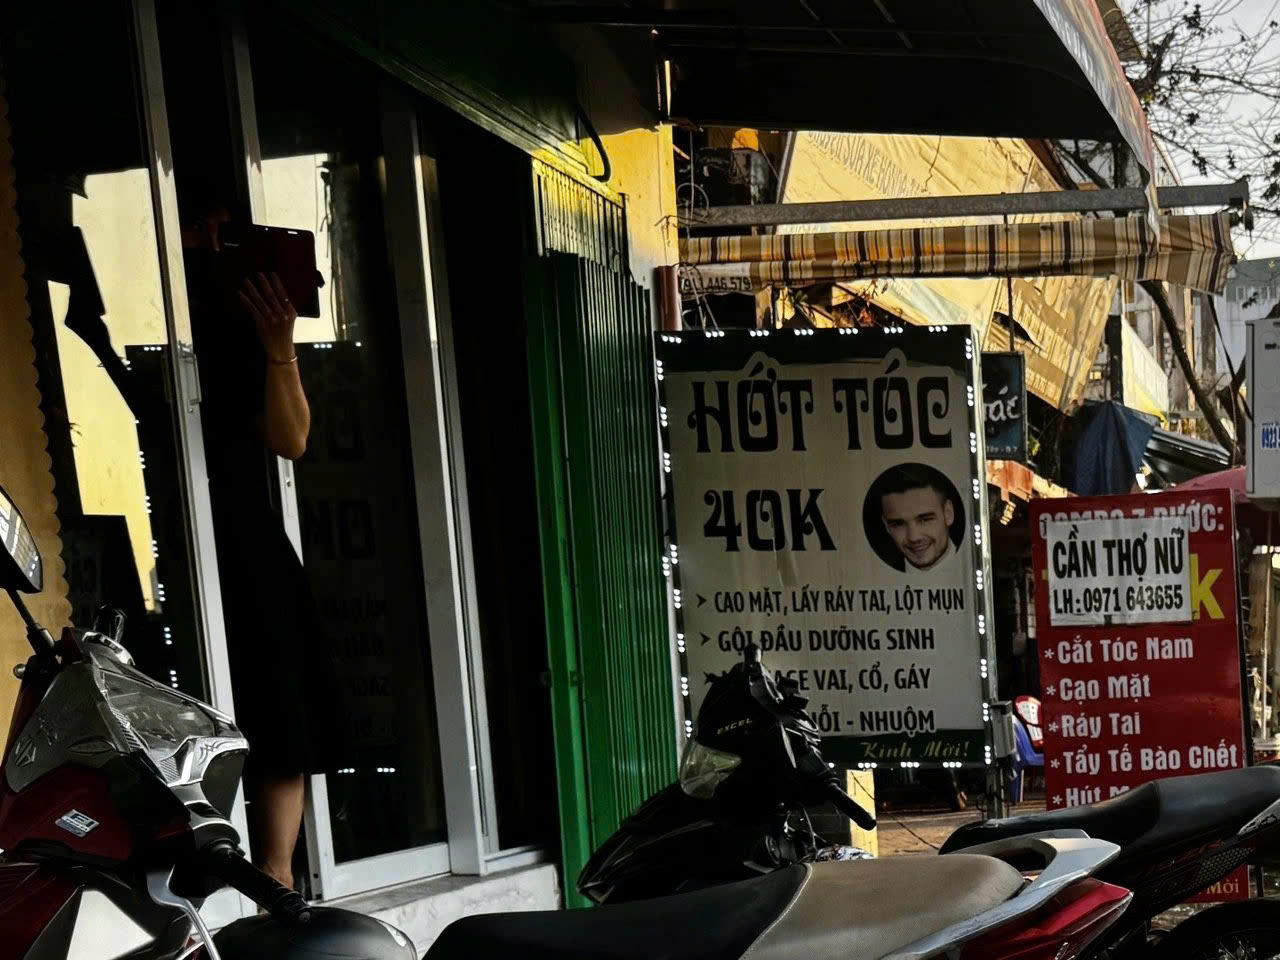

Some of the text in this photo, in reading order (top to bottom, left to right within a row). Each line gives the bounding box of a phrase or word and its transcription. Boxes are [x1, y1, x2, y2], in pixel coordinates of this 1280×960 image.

[688, 359, 952, 452] HỚT TÓC
[704, 489, 836, 552] 40K
[1053, 524, 1185, 582] CẦN THỢ NỮ
[714, 585, 965, 616] CAO MẶT, LẤY RÁY TAI, LỘT MỤN
[1126, 584, 1183, 611] 643655
[759, 624, 802, 652] ĐẦU
[809, 626, 881, 651] DƯỠNG
[887, 628, 935, 650] SINH
[1058, 635, 1194, 664] Cắt Tóc Nam
[814, 669, 853, 694] VAI,
[859, 661, 889, 693] CỔ,
[894, 663, 931, 690] GÁY
[1059, 673, 1151, 705] Cạo Mặt
[861, 705, 936, 736] NHUỘM
[1061, 711, 1141, 739] Ráy Tai
[1063, 738, 1238, 775] Tẩy Tế Bào Chết
